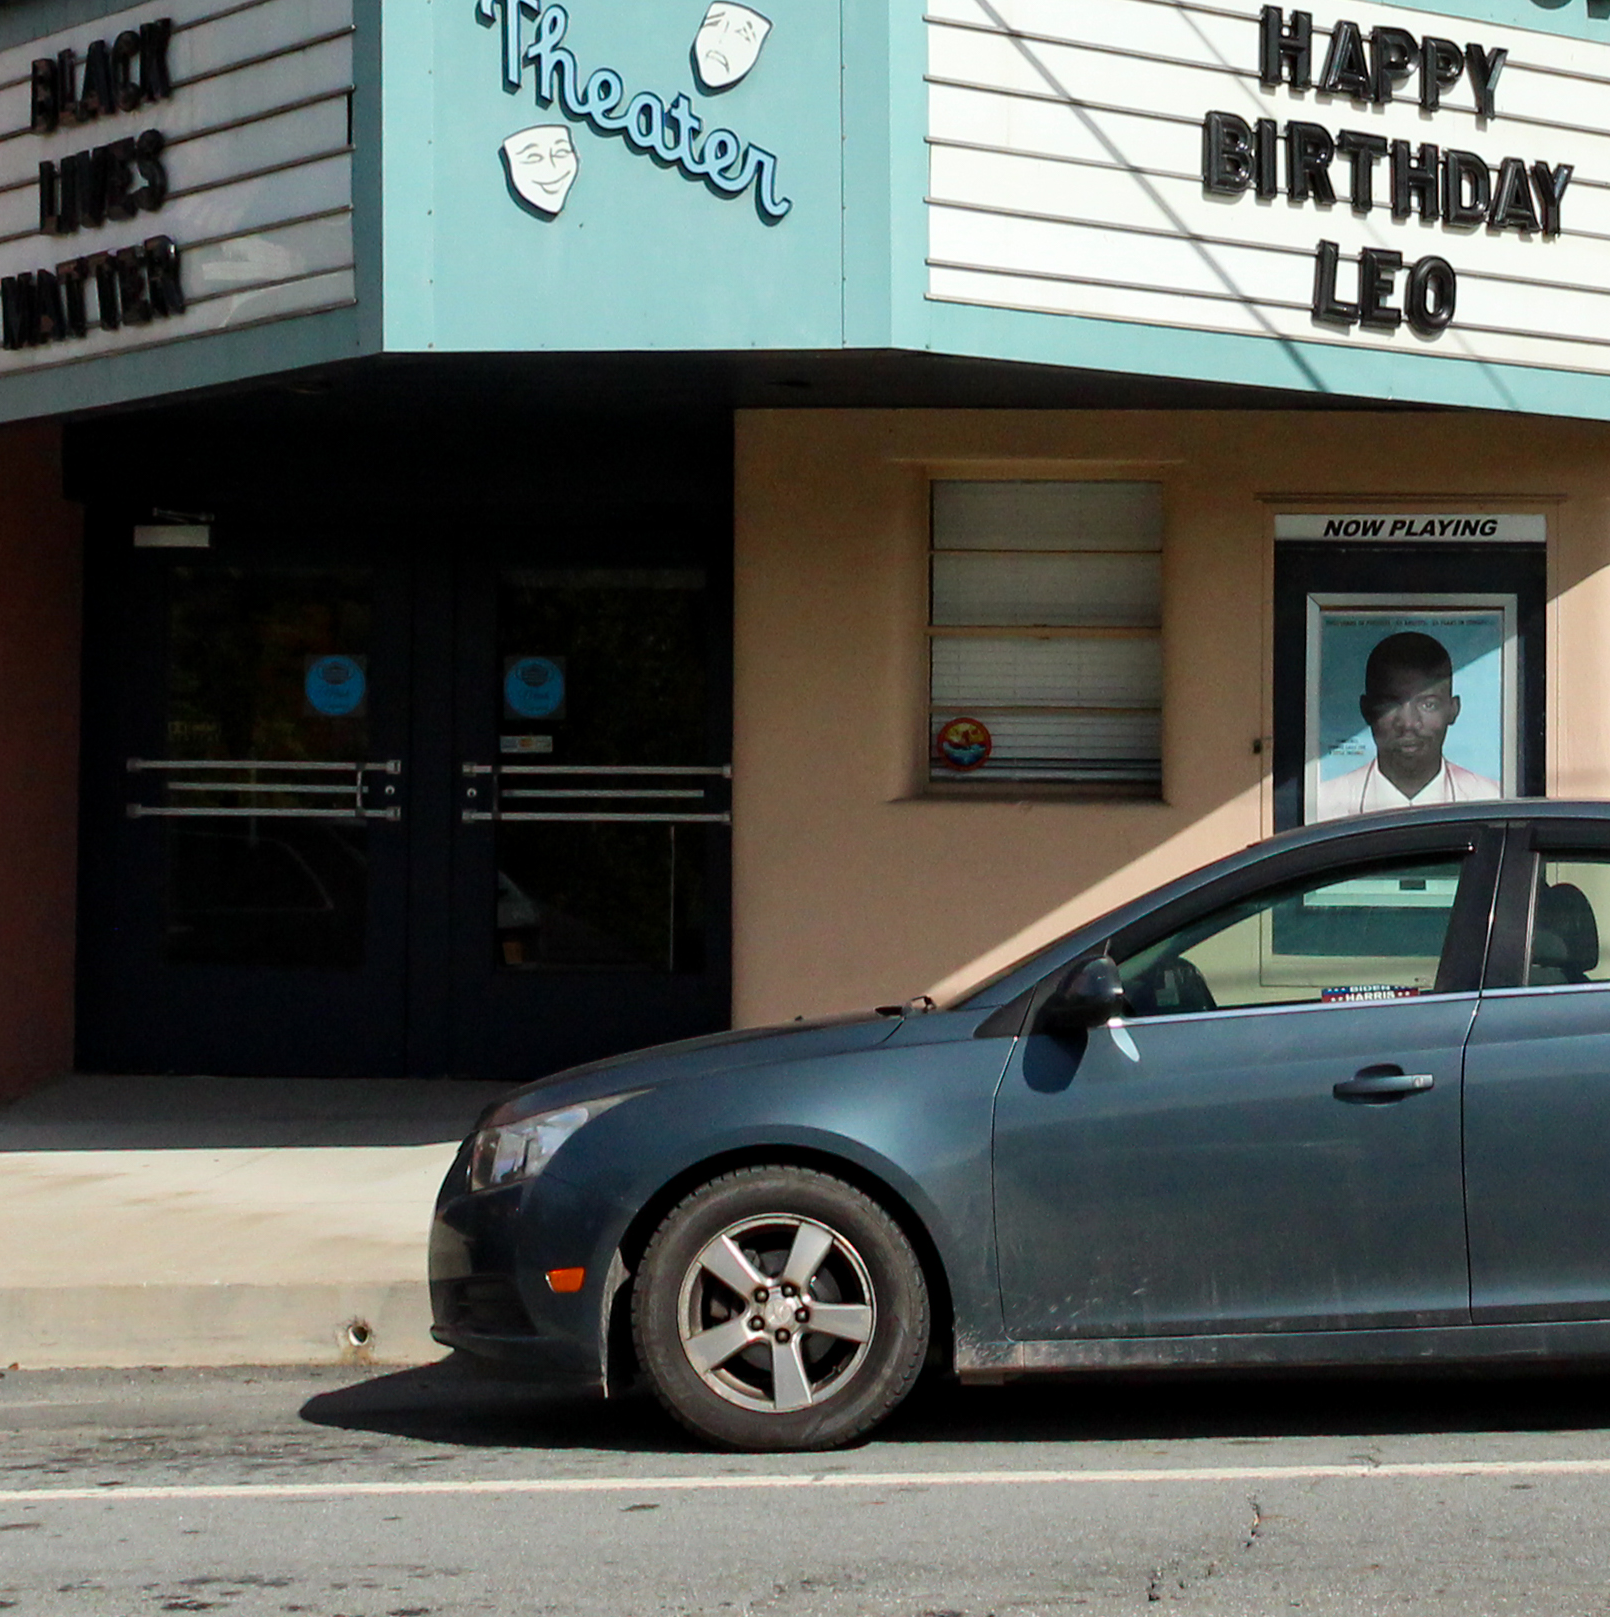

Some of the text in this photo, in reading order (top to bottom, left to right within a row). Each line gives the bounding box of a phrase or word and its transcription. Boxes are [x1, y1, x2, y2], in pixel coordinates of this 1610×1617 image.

[31, 18, 171, 134] BLACK
[1258, 4, 1509, 121] HAPPY
[39, 129, 168, 236] LIVES
[1202, 110, 1575, 238] BIRTHDAY
[1, 235, 186, 351] MATTER
[1311, 239, 1457, 335] LEO
[1323, 519, 1499, 537] NOW PLAYING
[1345, 991, 1396, 1002] HARRIS
[1349, 985, 1391, 993] BIDEN
